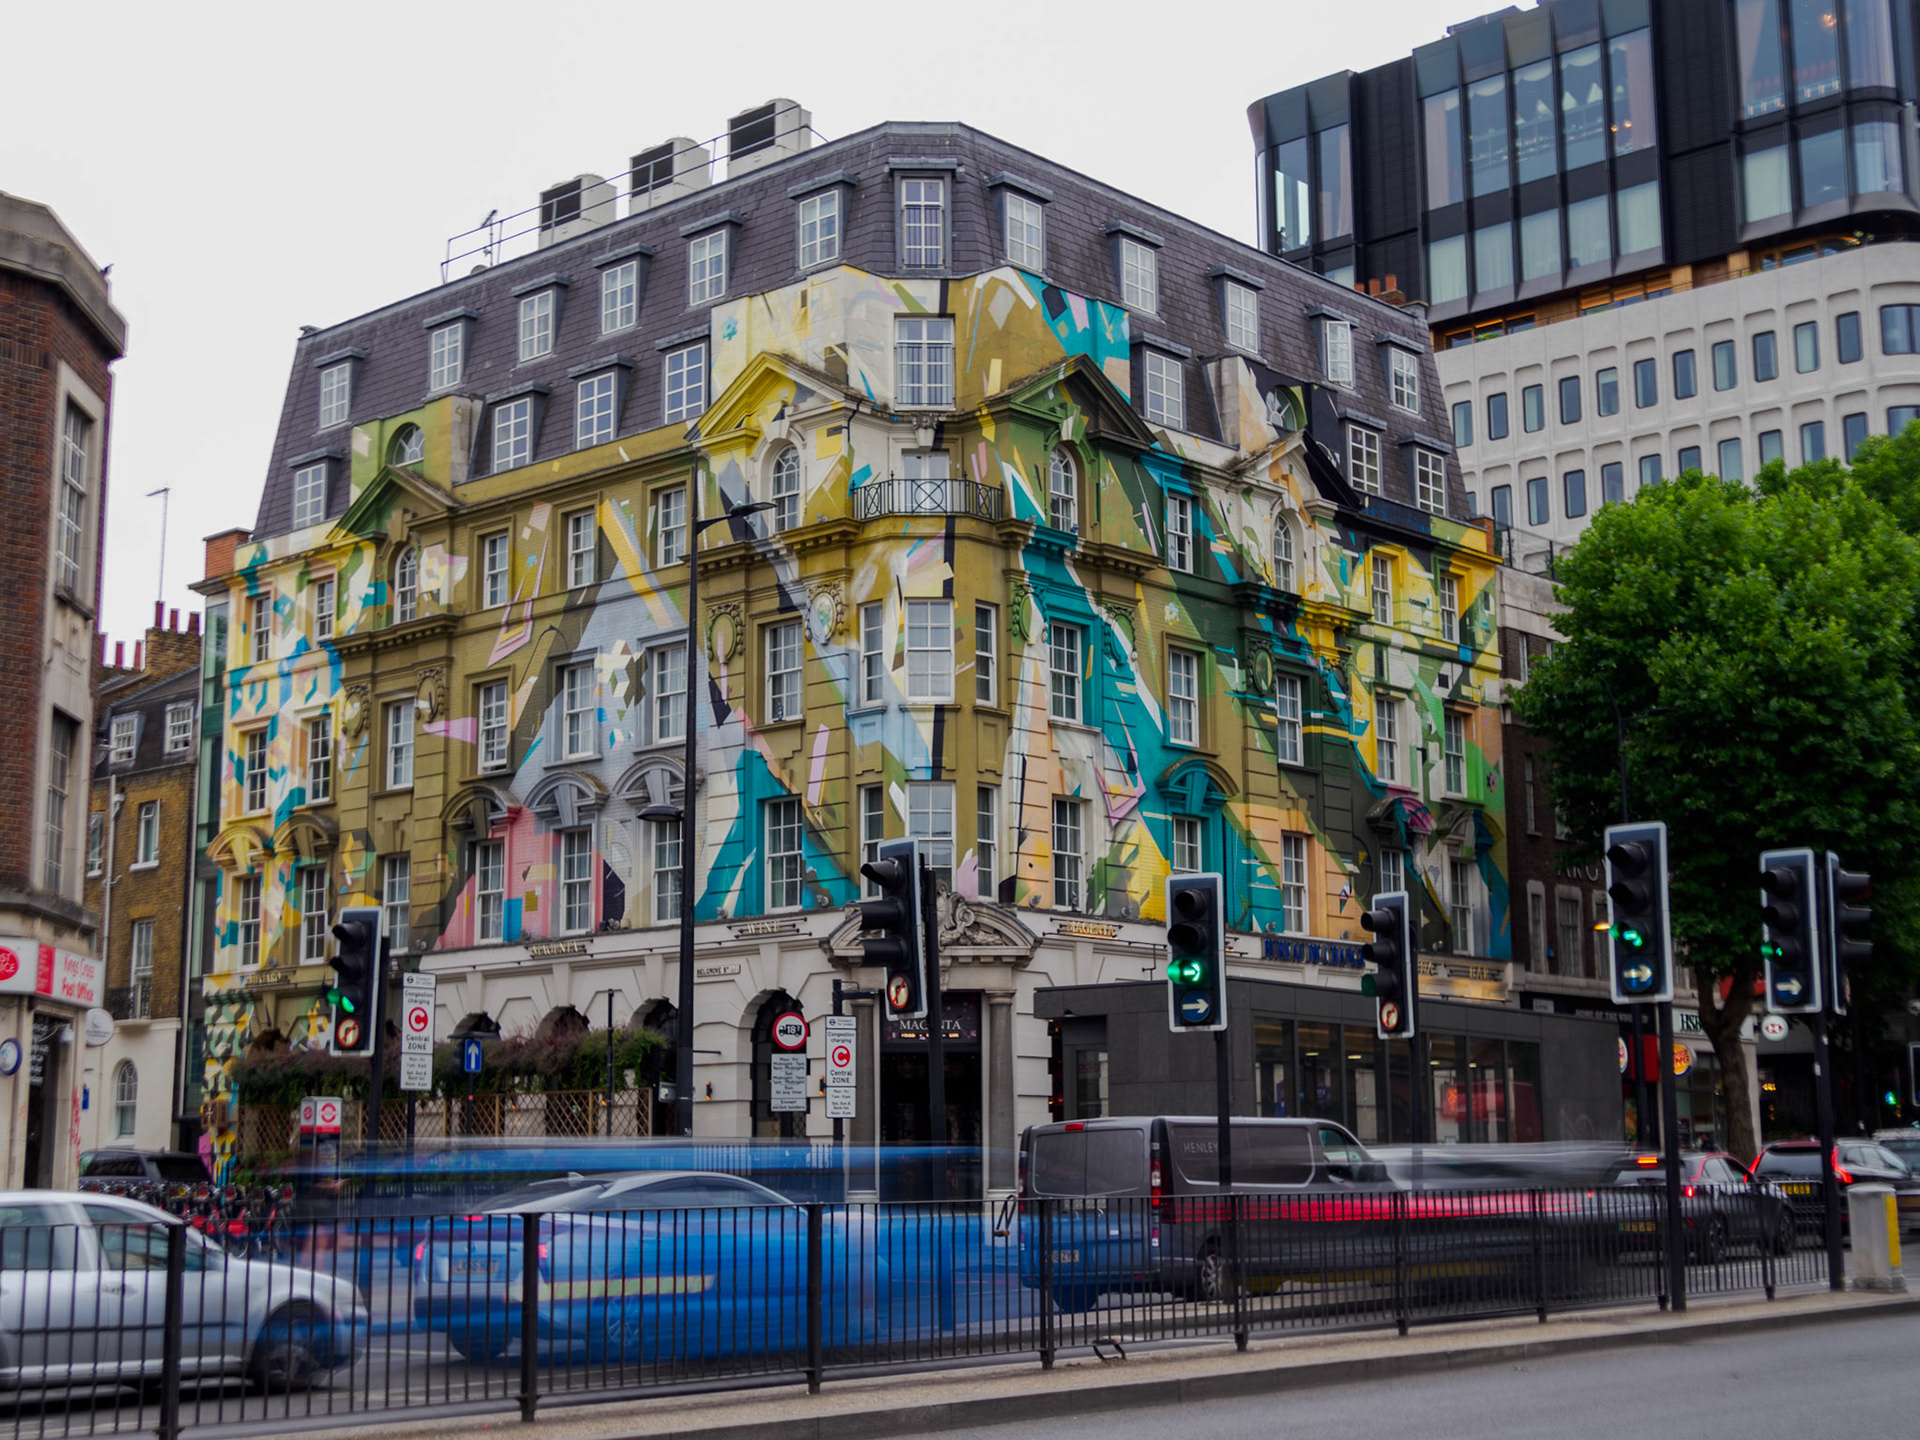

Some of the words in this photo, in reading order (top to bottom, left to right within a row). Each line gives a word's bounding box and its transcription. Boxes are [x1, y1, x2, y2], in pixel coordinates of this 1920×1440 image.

[747, 921, 779, 934] WINE
[1067, 920, 1115, 935] MAGENTA
[407, 1042, 427, 1050] ZONE
[1183, 1142, 1219, 1154] HENLEY
